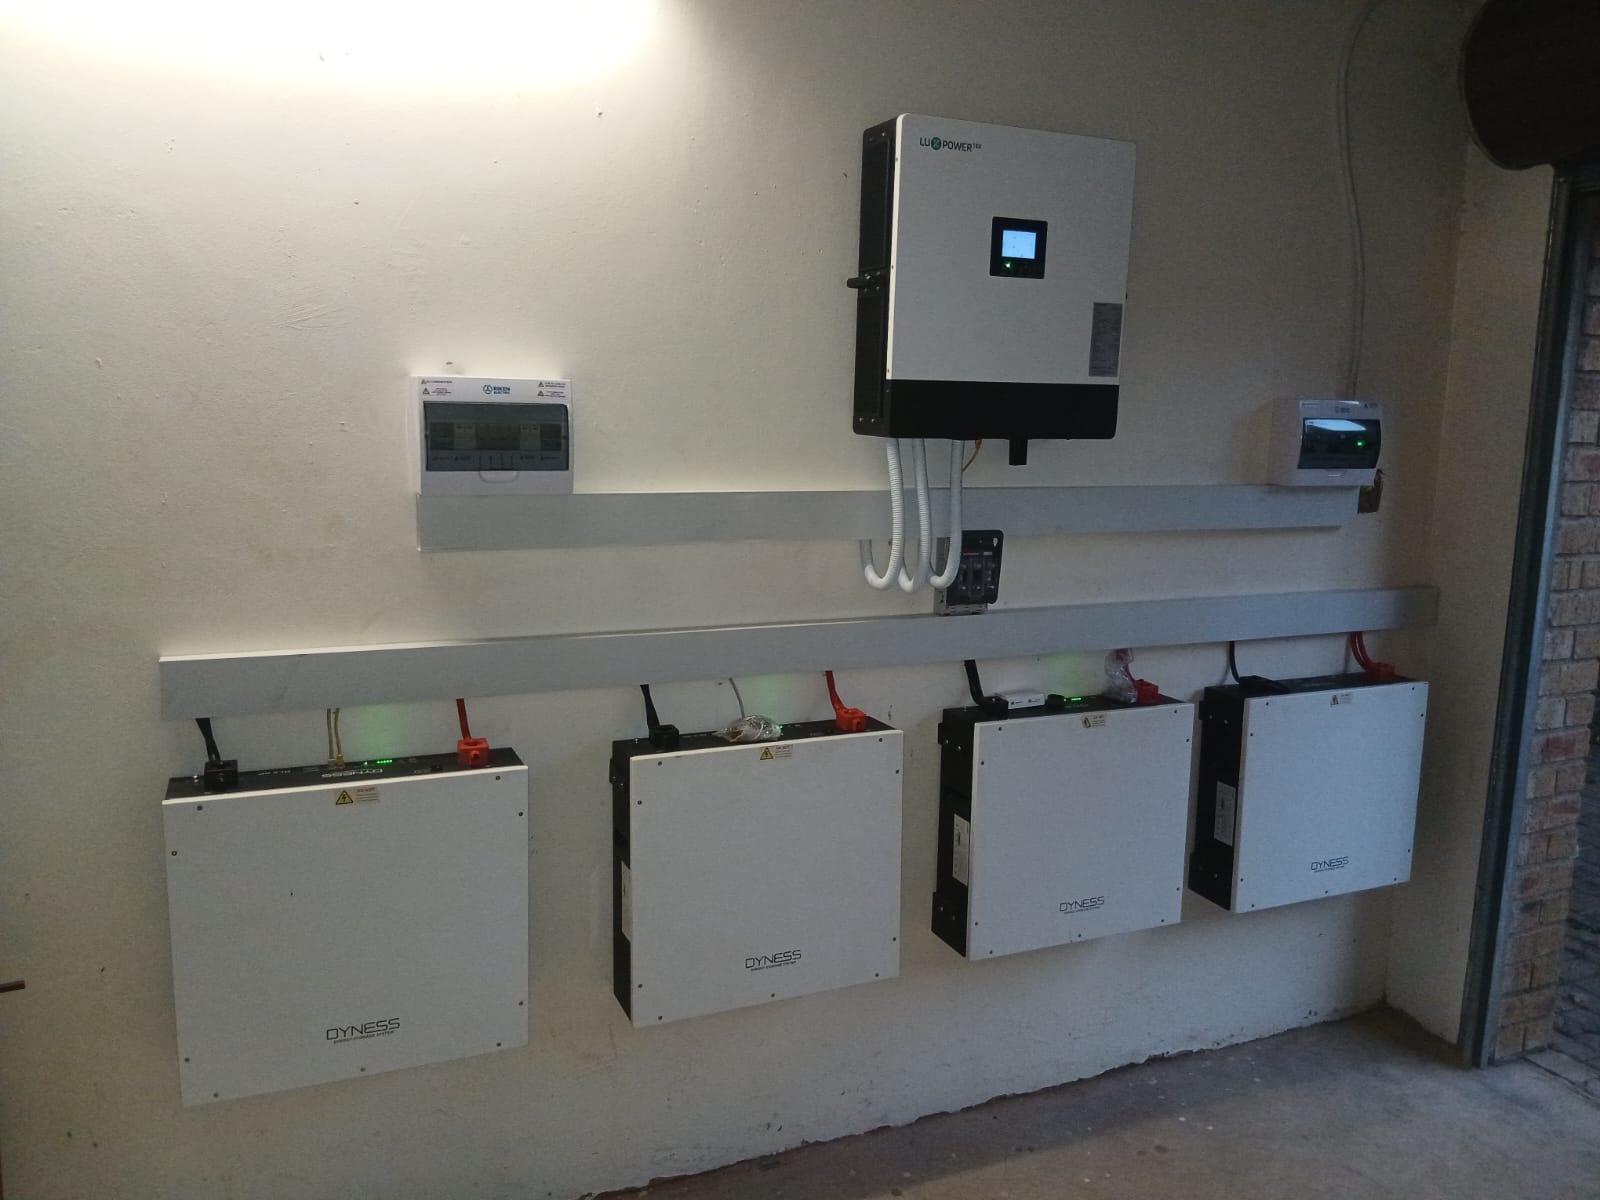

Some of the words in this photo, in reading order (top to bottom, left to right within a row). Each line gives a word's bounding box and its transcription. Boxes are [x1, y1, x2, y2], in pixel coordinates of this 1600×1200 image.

[1310, 856, 1349, 871] DYNESS
[1059, 895, 1105, 912] DYNESS
[745, 949, 802, 969] DYNESS
[326, 1017, 400, 1040] DYNESS
